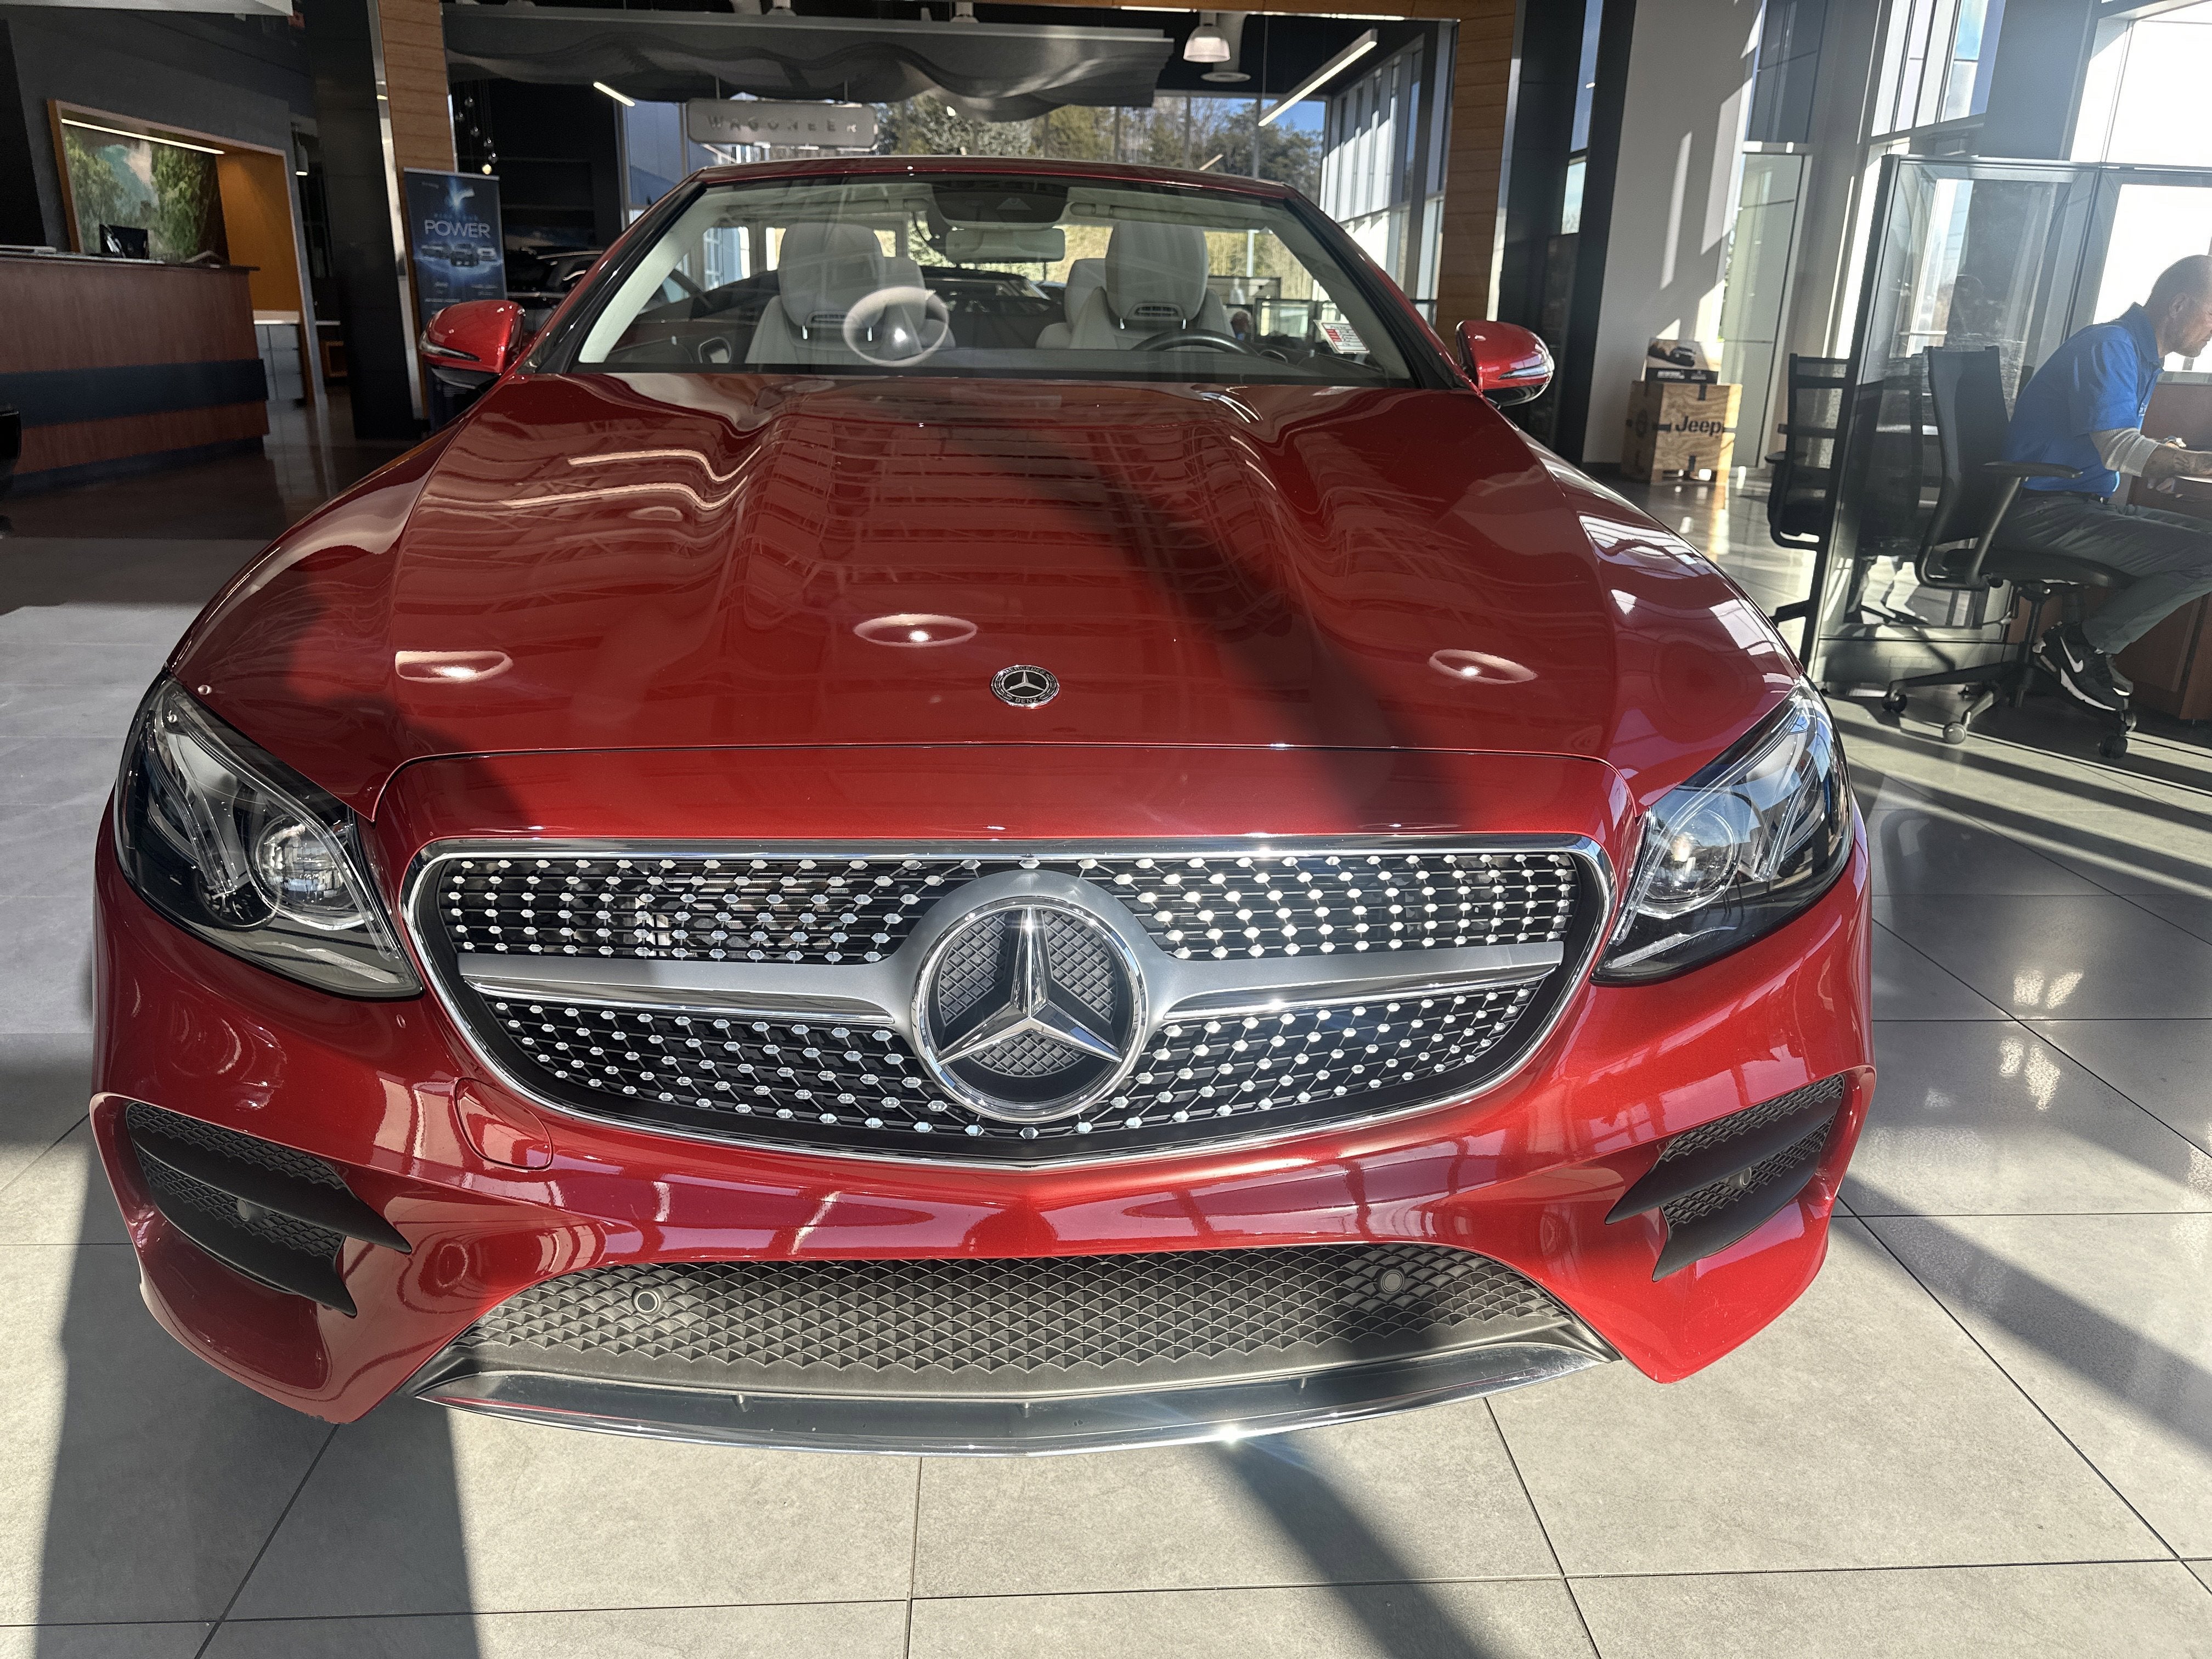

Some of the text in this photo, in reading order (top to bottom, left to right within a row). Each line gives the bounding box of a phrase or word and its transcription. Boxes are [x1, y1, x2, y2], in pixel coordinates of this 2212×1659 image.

[425, 219, 492, 239] POWER
[1675, 416, 1722, 436] Jeep
[1005, 665, 1046, 674] MERCEDES
